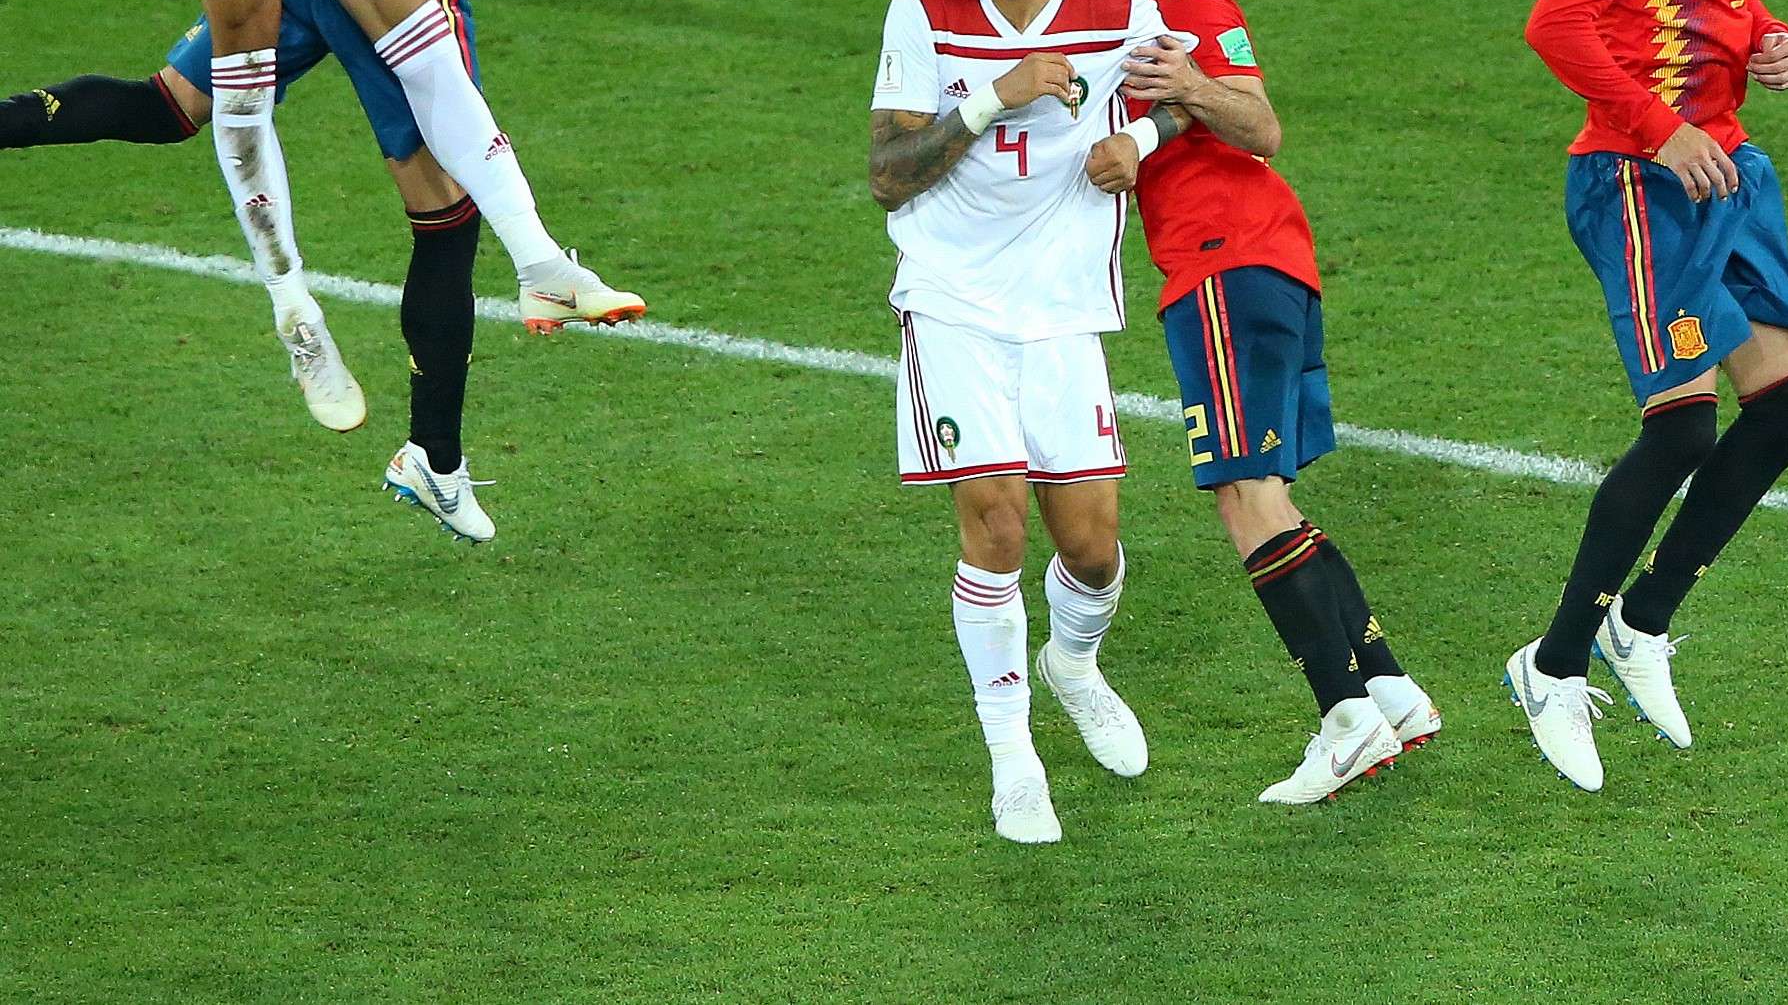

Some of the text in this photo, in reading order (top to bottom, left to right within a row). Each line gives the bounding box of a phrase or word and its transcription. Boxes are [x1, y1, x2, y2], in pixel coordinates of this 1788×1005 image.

[996, 124, 1028, 177] 4
[1096, 405, 1119, 461] 4
[1183, 404, 1214, 467] 2
